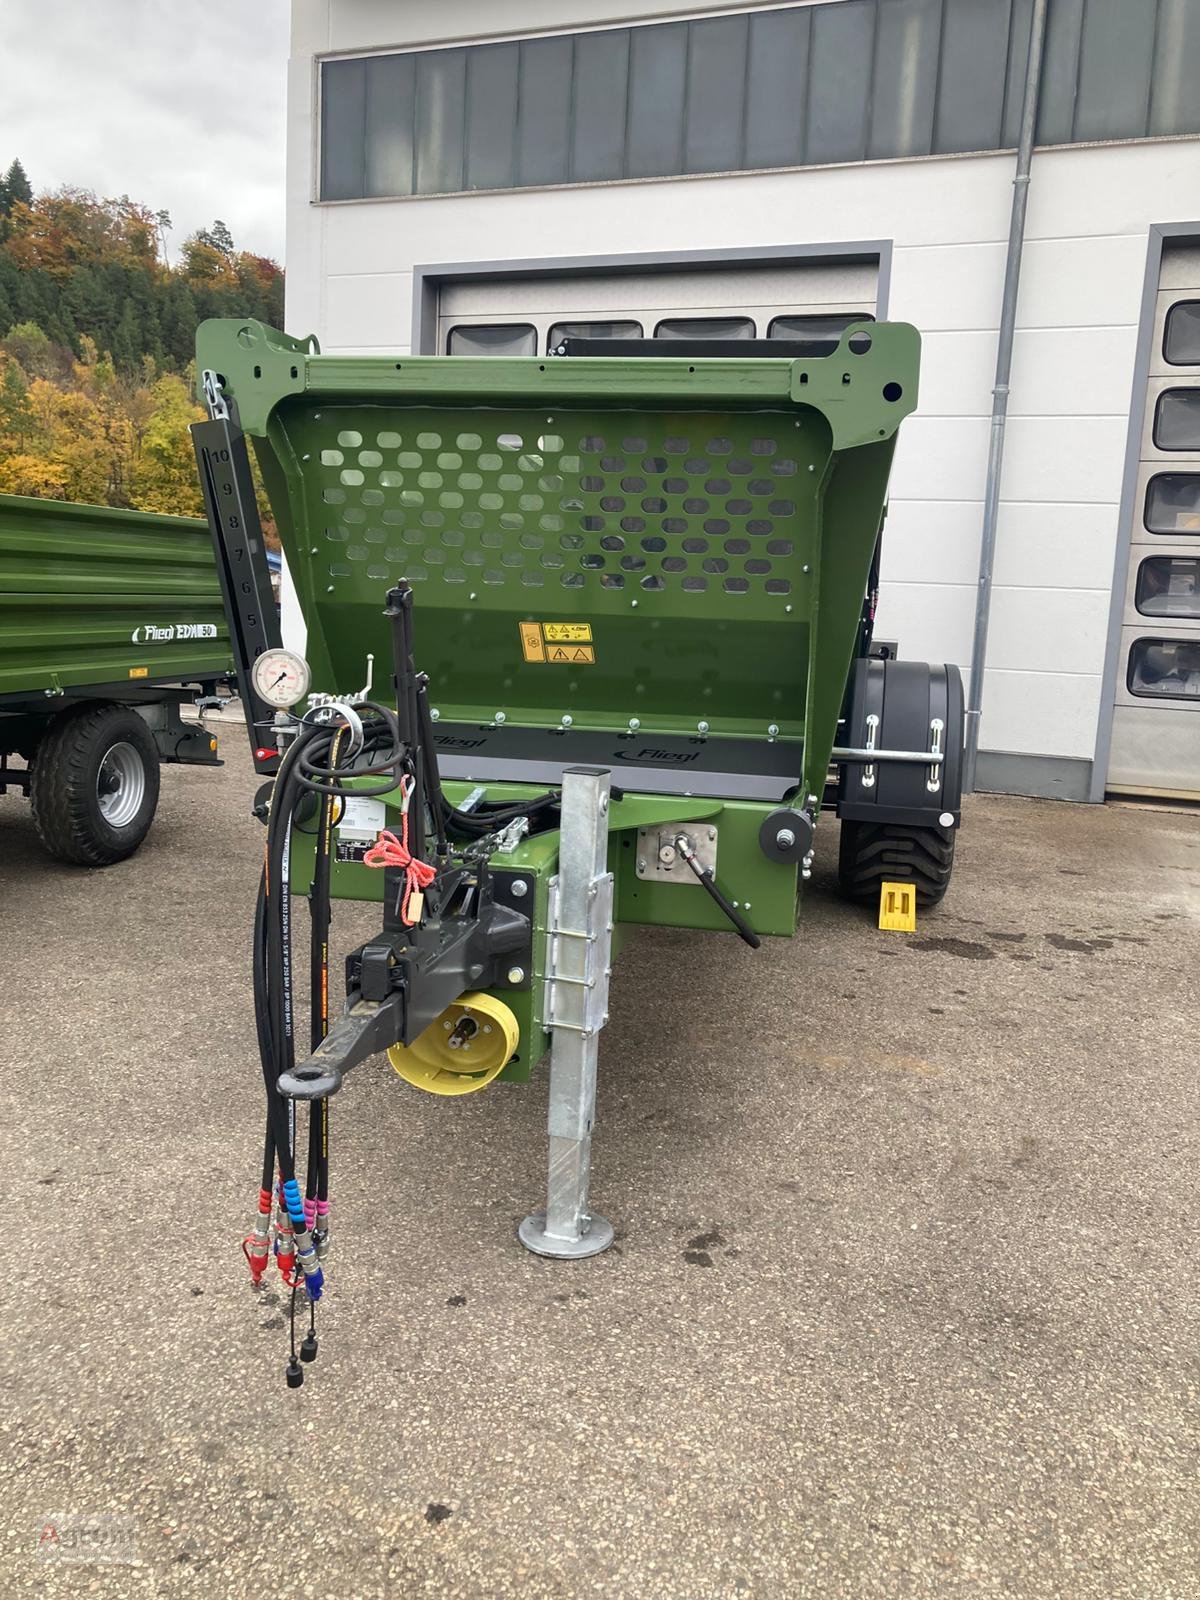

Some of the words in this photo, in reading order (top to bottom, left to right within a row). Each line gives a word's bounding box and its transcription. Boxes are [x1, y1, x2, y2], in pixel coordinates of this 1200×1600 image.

[211, 449, 229, 464] 10
[222, 483, 232, 496] 9
[228, 516, 239, 529] 8
[234, 548, 244, 562] 7
[241, 581, 251, 594] 6
[247, 613, 257, 626] 5
[144, 624, 175, 641] Fliegl
[637, 748, 701, 763] Fliegl
